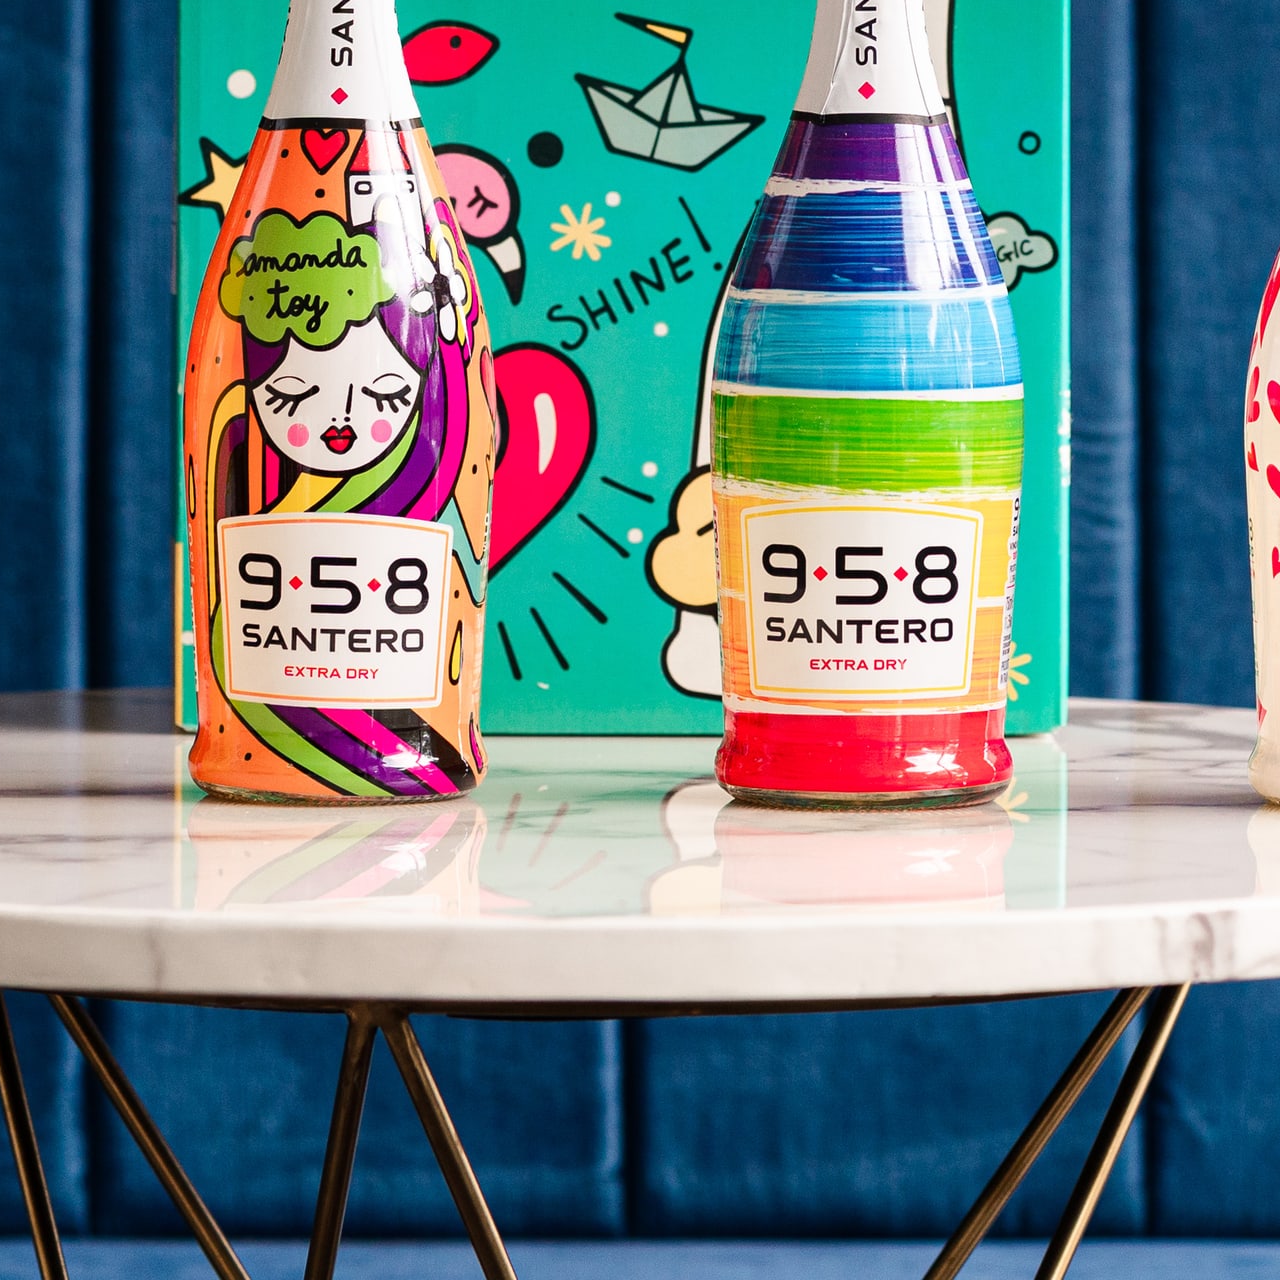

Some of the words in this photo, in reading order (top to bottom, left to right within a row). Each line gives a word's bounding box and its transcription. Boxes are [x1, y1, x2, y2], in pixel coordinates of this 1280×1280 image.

[236, 238, 367, 276] amanda
[996, 239, 1034, 263] GIC
[547, 195, 723, 351] SHINE!
[266, 279, 329, 333] toy
[242, 623, 424, 653] SANTERO
[766, 616, 954, 644] SANTERO
[283, 664, 342, 679] EXTRA
[346, 667, 379, 680] DRY
[809, 658, 868, 671] EXTRA
[873, 658, 908, 671] DRY
